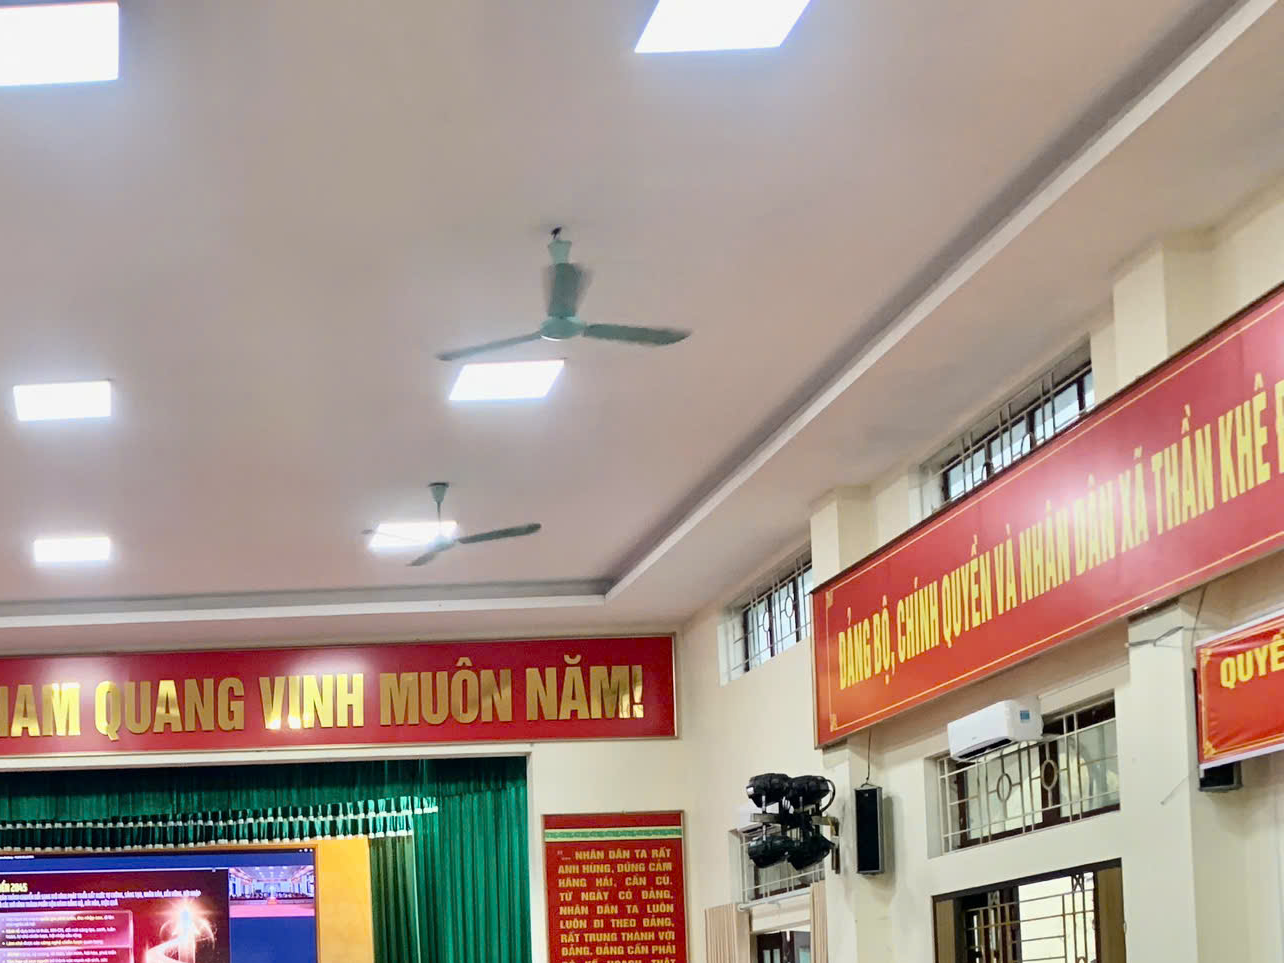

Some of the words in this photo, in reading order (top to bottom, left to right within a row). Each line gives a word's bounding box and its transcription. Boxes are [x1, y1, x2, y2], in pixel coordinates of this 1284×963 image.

[838, 606, 872, 690] ĐẢNG
[873, 594, 896, 685] BỘ,
[897, 576, 940, 663] CHÍNH
[941, 534, 993, 648] QUYỀN
[993, 523, 1018, 616] VÀ
[1019, 499, 1071, 604] NHÂN
[1073, 473, 1116, 577] DÂN
[1118, 445, 1150, 553] XÃ
[1151, 403, 1215, 536] THẦN
[1218, 371, 1271, 504] KHÊ
[94, 677, 245, 741] QUANG
[259, 673, 365, 731] VINH
[379, 656, 511, 726] MUÔN
[526, 654, 644, 721] NĂM!
[575, 849, 604, 860] NHÂN
[609, 848, 630, 860] DÂN
[635, 849, 647, 859] TA
[558, 864, 579, 874] ANH
[559, 904, 589, 915] NHÂN
[596, 904, 618, 915] DÂN
[625, 904, 639, 914] TA
[647, 902, 674, 913] LUÔN
[560, 918, 587, 929] LUÔN
[610, 918, 637, 928] THEO
[583, 933, 617, 942] TRUNG
